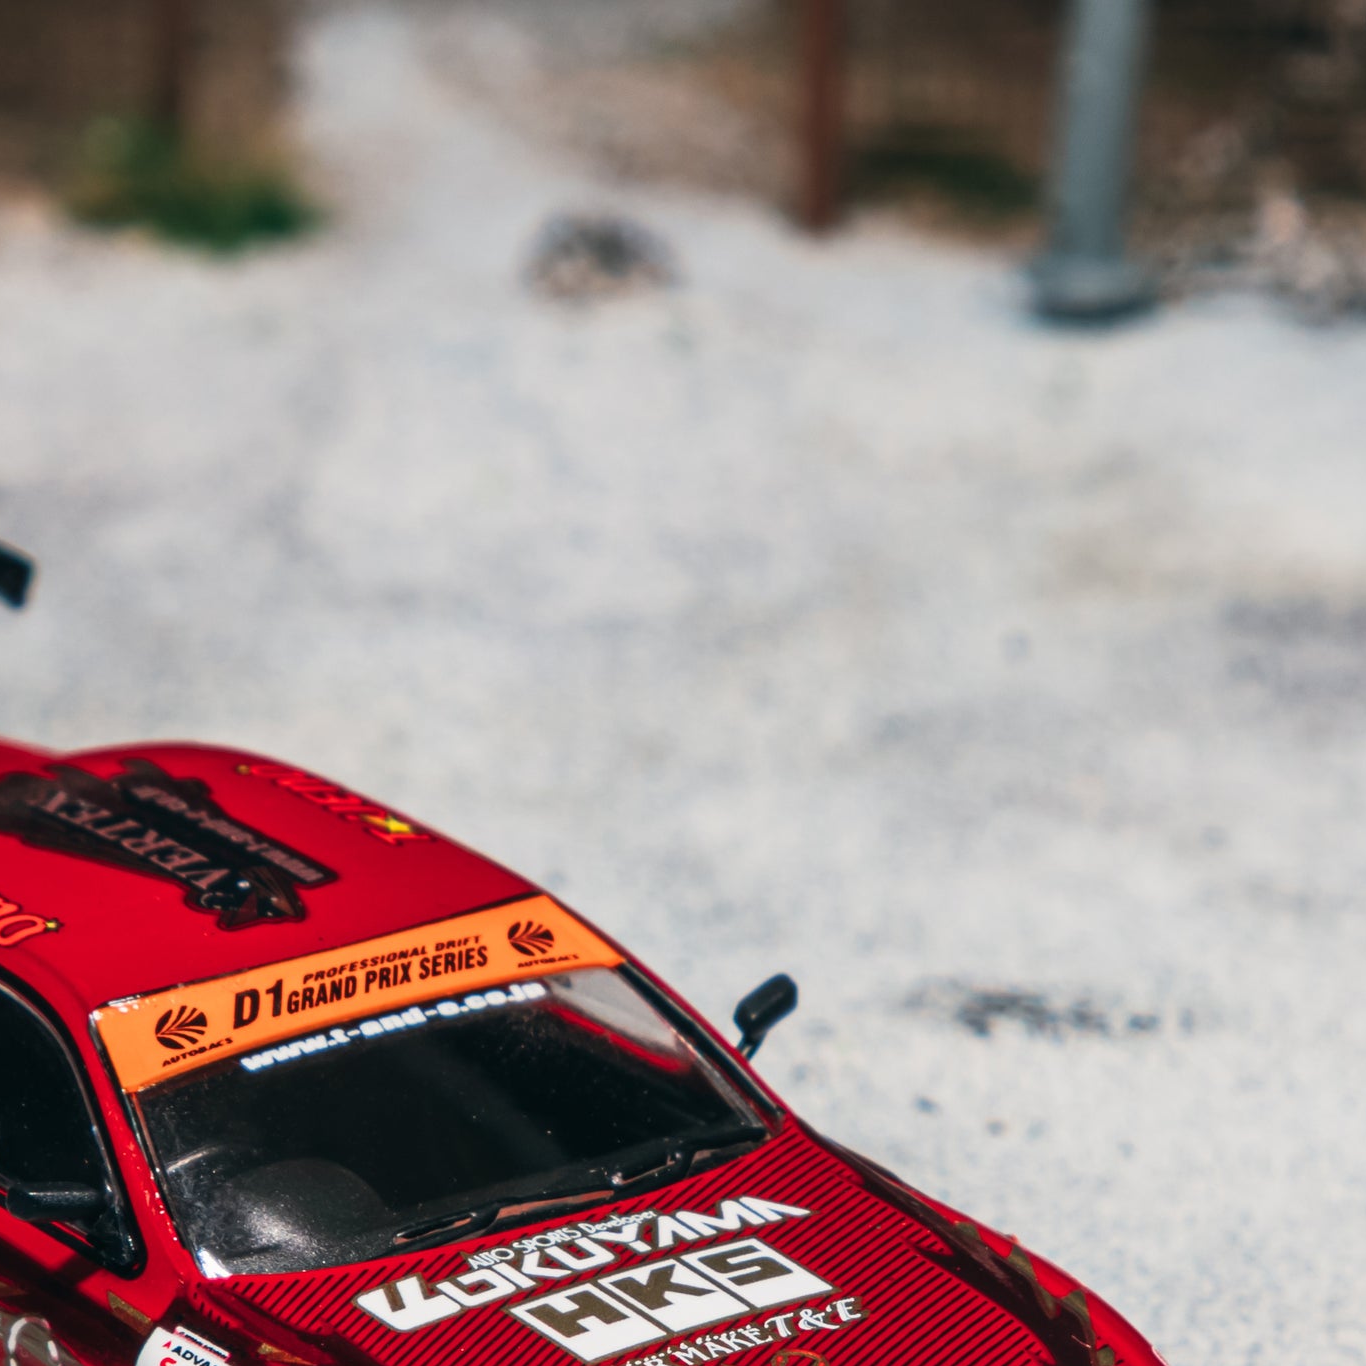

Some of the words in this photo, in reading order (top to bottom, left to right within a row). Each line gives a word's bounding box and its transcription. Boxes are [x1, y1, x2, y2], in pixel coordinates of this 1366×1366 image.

[233, 978, 283, 1029] D1
[286, 976, 358, 1015] GRAND
[364, 960, 412, 995] PRIX
[417, 945, 490, 981] SERIES
[302, 945, 427, 985] PROFESSIONAL
[434, 934, 483, 953] DRIFT
[517, 953, 580, 969] AUTOBACS
[161, 1036, 234, 1068] AUTOBACS
[240, 982, 548, 1072] www.t-and-e.co.jp
[468, 1247, 514, 1270] AUTO
[513, 1227, 581, 1254] SPORTS
[578, 1210, 658, 1235] Developer
[525, 1245, 795, 1339] HKS
